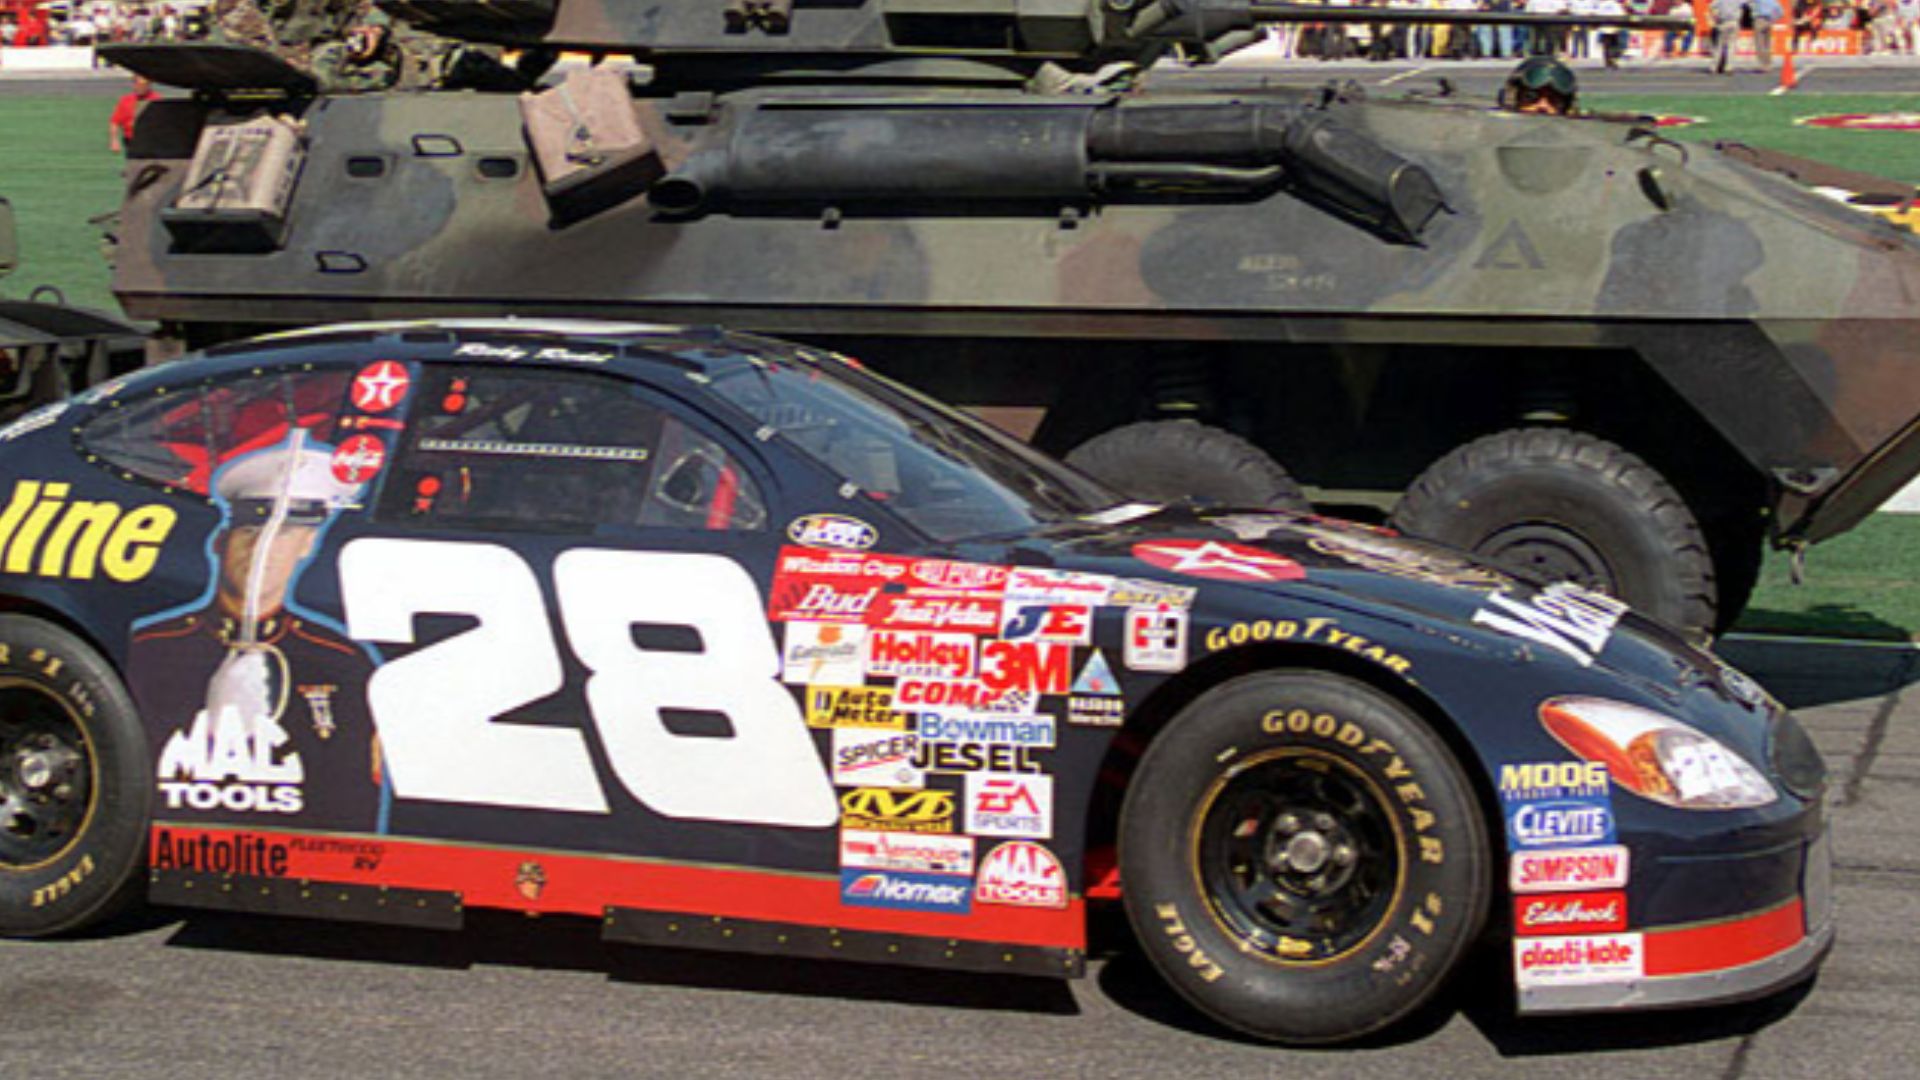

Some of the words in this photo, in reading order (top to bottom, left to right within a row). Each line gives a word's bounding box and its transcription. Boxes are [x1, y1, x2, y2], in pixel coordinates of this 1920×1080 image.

[796, 583, 879, 613] Bud
[1003, 605, 1089, 640] JE
[870, 632, 971, 678] Holley
[980, 641, 1070, 693] 3M
[338, 537, 841, 828] 28
[837, 688, 893, 708] Auto
[829, 706, 898, 725] Meter
[921, 711, 1054, 744] Bowman
[157, 704, 304, 781] MAC
[837, 733, 919, 767] SPICER
[909, 741, 1039, 773] JESEL
[1261, 709, 1444, 865] GOODYEAR
[1500, 760, 1609, 791] MOOG
[157, 782, 304, 813] TOOLS
[975, 779, 1041, 815] EA
[973, 815, 1042, 833] SPORTS
[157, 830, 289, 877] Autolite
[1519, 853, 1619, 885] SIMPSON
[873, 873, 967, 904] Nomex
[1520, 938, 1633, 969] plasti-kote
